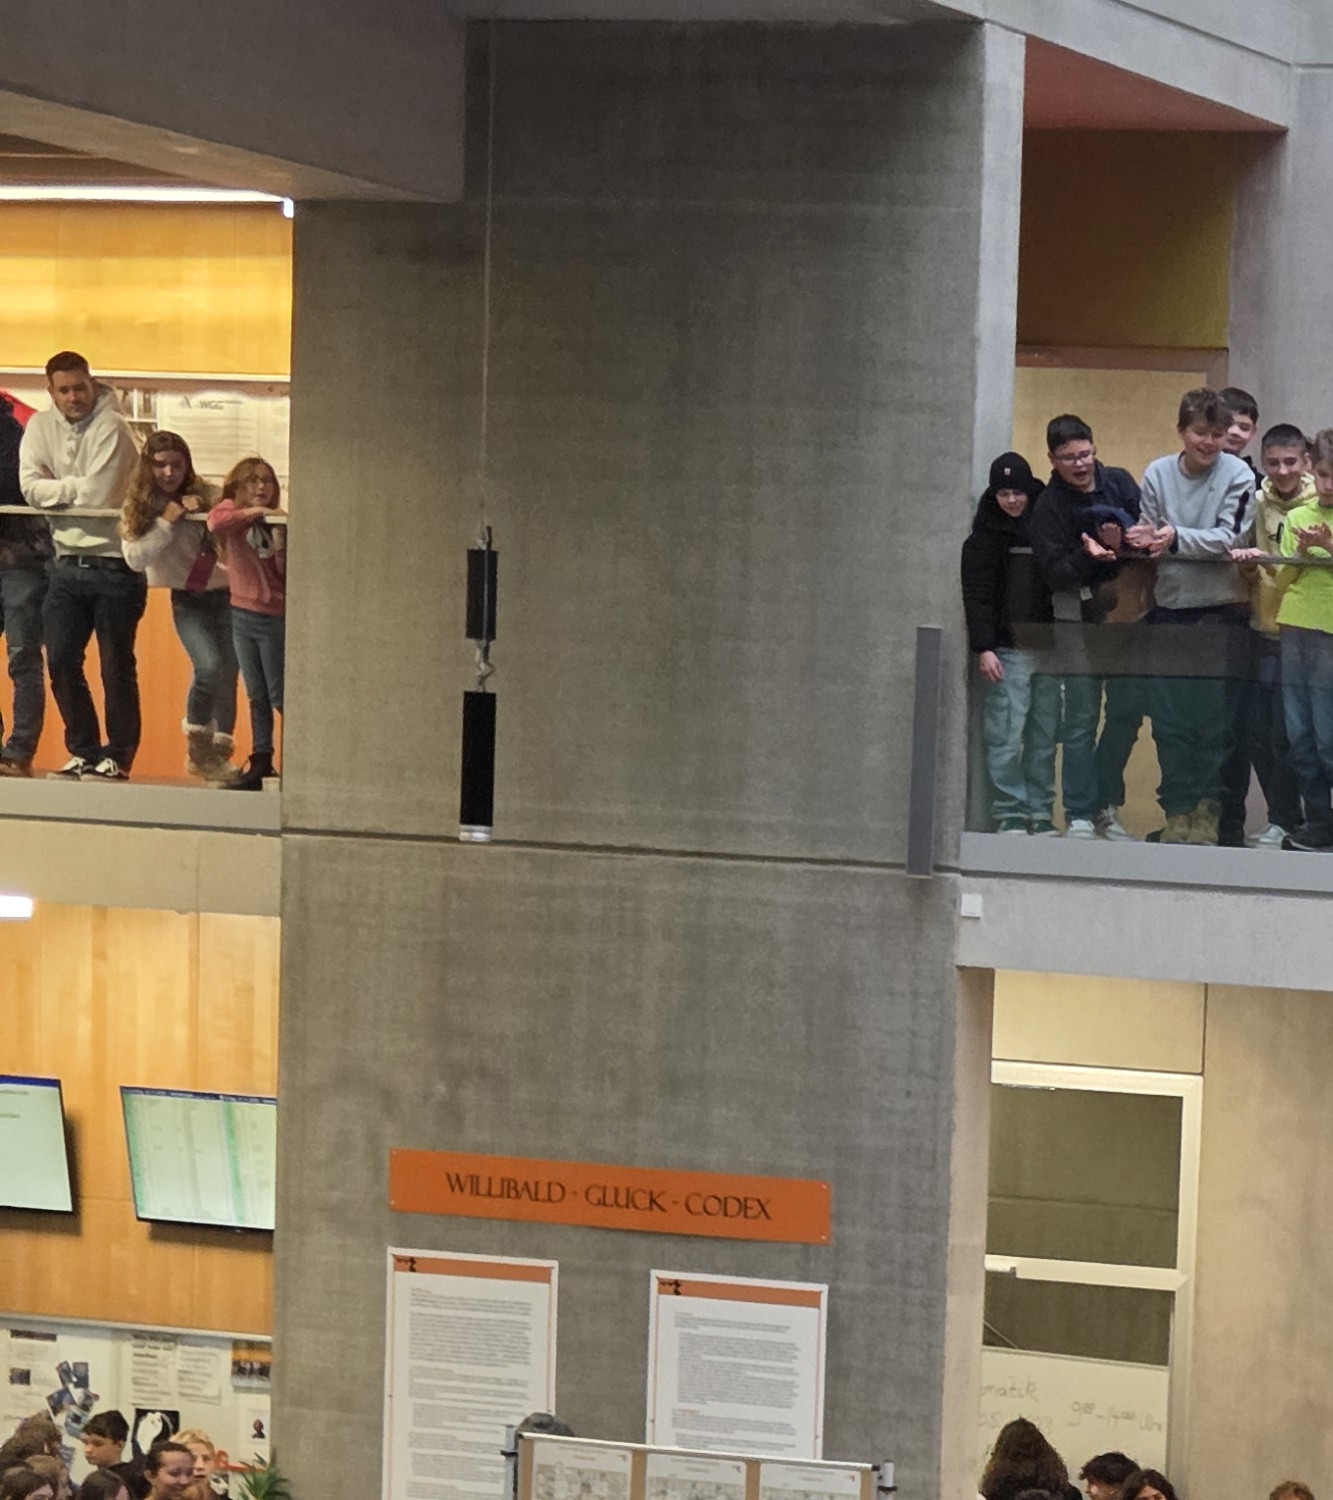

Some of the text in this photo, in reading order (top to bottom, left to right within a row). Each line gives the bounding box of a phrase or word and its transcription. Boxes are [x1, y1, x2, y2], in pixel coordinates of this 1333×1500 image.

[445, 1171, 566, 1204] WILLIBALD
[584, 1184, 668, 1213] GLUCK
[684, 1192, 773, 1221] CODEX
